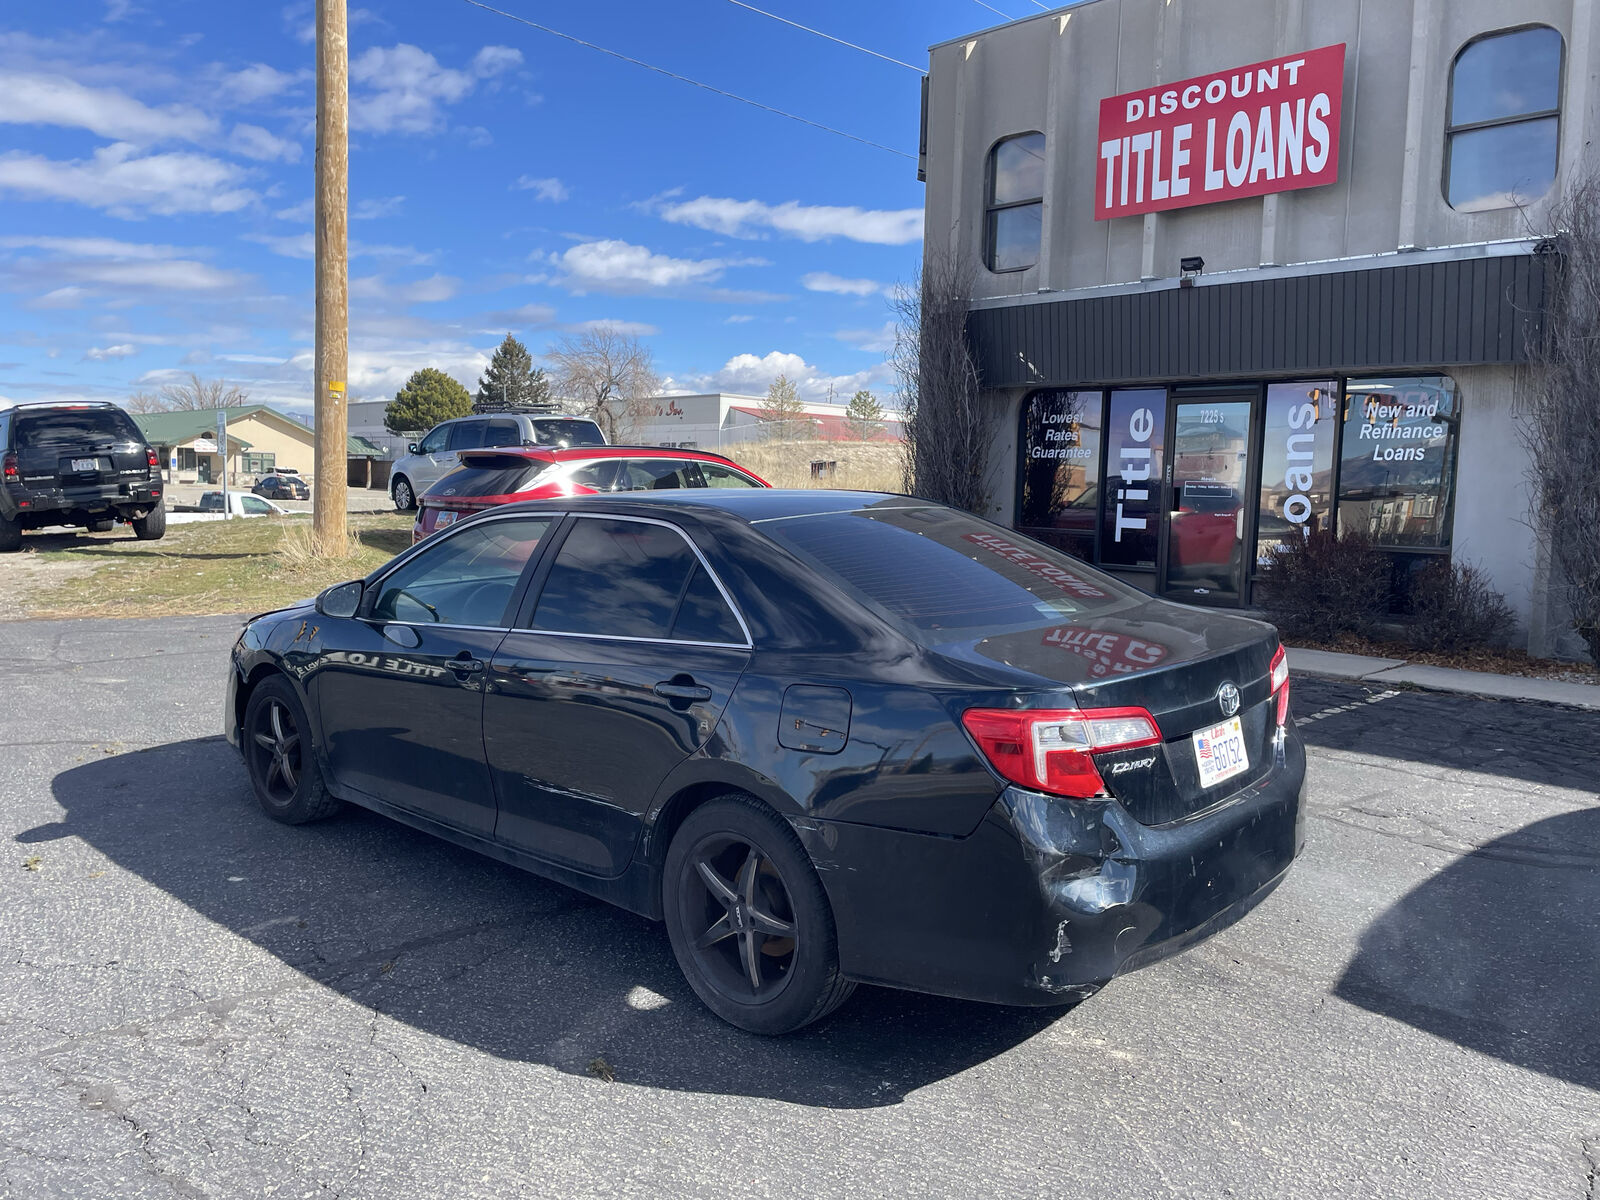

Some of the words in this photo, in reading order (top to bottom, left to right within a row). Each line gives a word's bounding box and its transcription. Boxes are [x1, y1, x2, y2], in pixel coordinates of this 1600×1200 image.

[1126, 59, 1305, 123] DISCOUNT
[1101, 123, 1192, 209] TITLE
[1204, 92, 1331, 191] LOANS
[1200, 409, 1218, 424] 7225
[1366, 402, 1403, 418] New
[1406, 400, 1438, 417] and
[1042, 411, 1084, 424] Lowest
[1045, 429, 1079, 441] Rates
[1359, 424, 1443, 440] Refinance
[1032, 446, 1092, 459] Guarantee
[1373, 444, 1425, 461] Loans
[1115, 408, 1154, 542] Title
